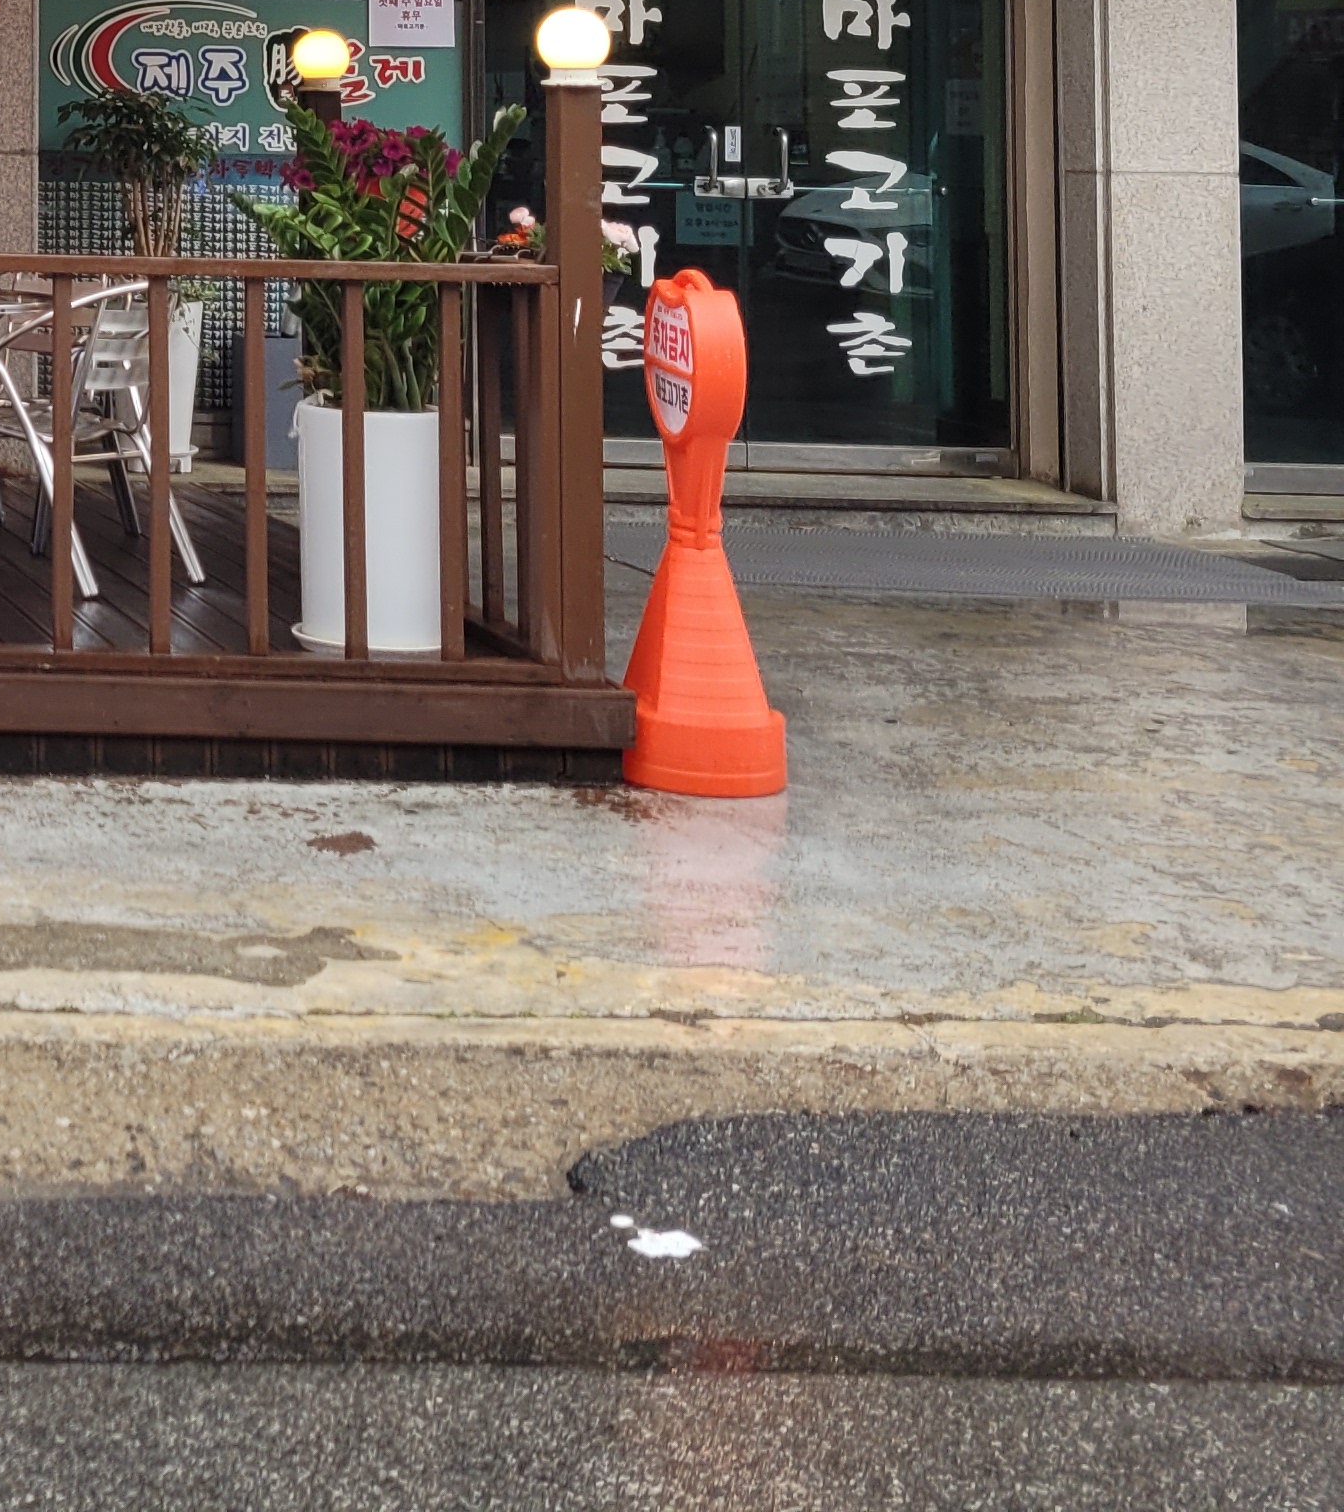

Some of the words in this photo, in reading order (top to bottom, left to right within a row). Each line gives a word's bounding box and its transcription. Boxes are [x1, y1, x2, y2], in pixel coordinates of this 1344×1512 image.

[401, 10, 422, 22] 휴무
[132, 46, 249, 105] 제주
[653, 316, 690, 368] 주차금지
